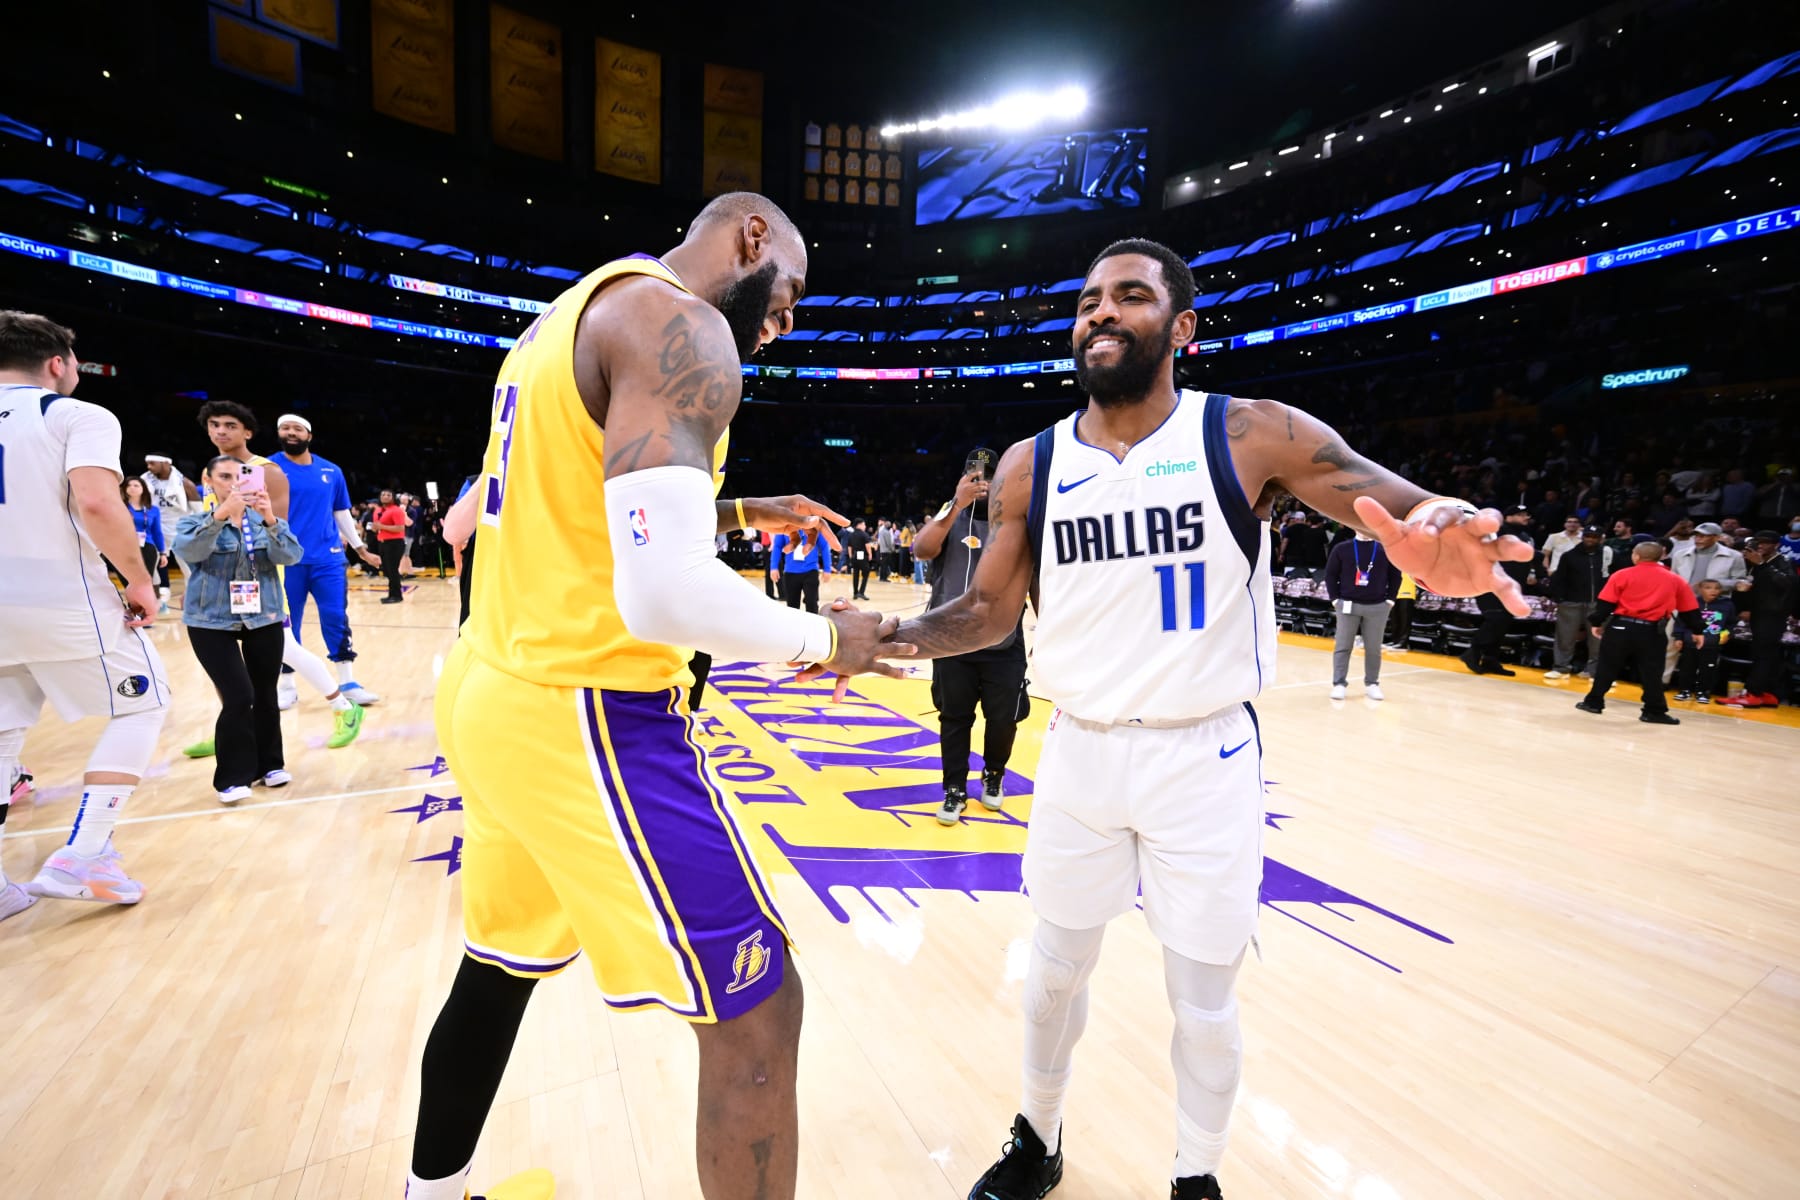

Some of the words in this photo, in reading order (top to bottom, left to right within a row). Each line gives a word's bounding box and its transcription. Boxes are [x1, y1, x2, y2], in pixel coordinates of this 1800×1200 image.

[1736, 209, 1800, 236] DELT
[0, 237, 57, 258] ectrum
[1615, 238, 1685, 261] crypto.com
[81, 256, 108, 270] UCLA
[117, 264, 154, 281] Health
[1497, 261, 1582, 290] TOSHIBA
[180, 280, 229, 296] crypto.com
[1422, 294, 1447, 308] UCLA
[1452, 285, 1488, 301] Health
[310, 304, 369, 327] TOSHIBA
[1317, 318, 1344, 330] ULTRA
[1353, 304, 1406, 322] Spectrum
[403, 324, 428, 334] ULTRA
[445, 330, 481, 343] DELTA
[1199, 342, 1223, 351] TOYOTA
[1601, 367, 1689, 389] Spectrum
[1145, 459, 1197, 477] chime
[1052, 500, 1206, 566] DALLAS
[1152, 559, 1207, 633] 11
